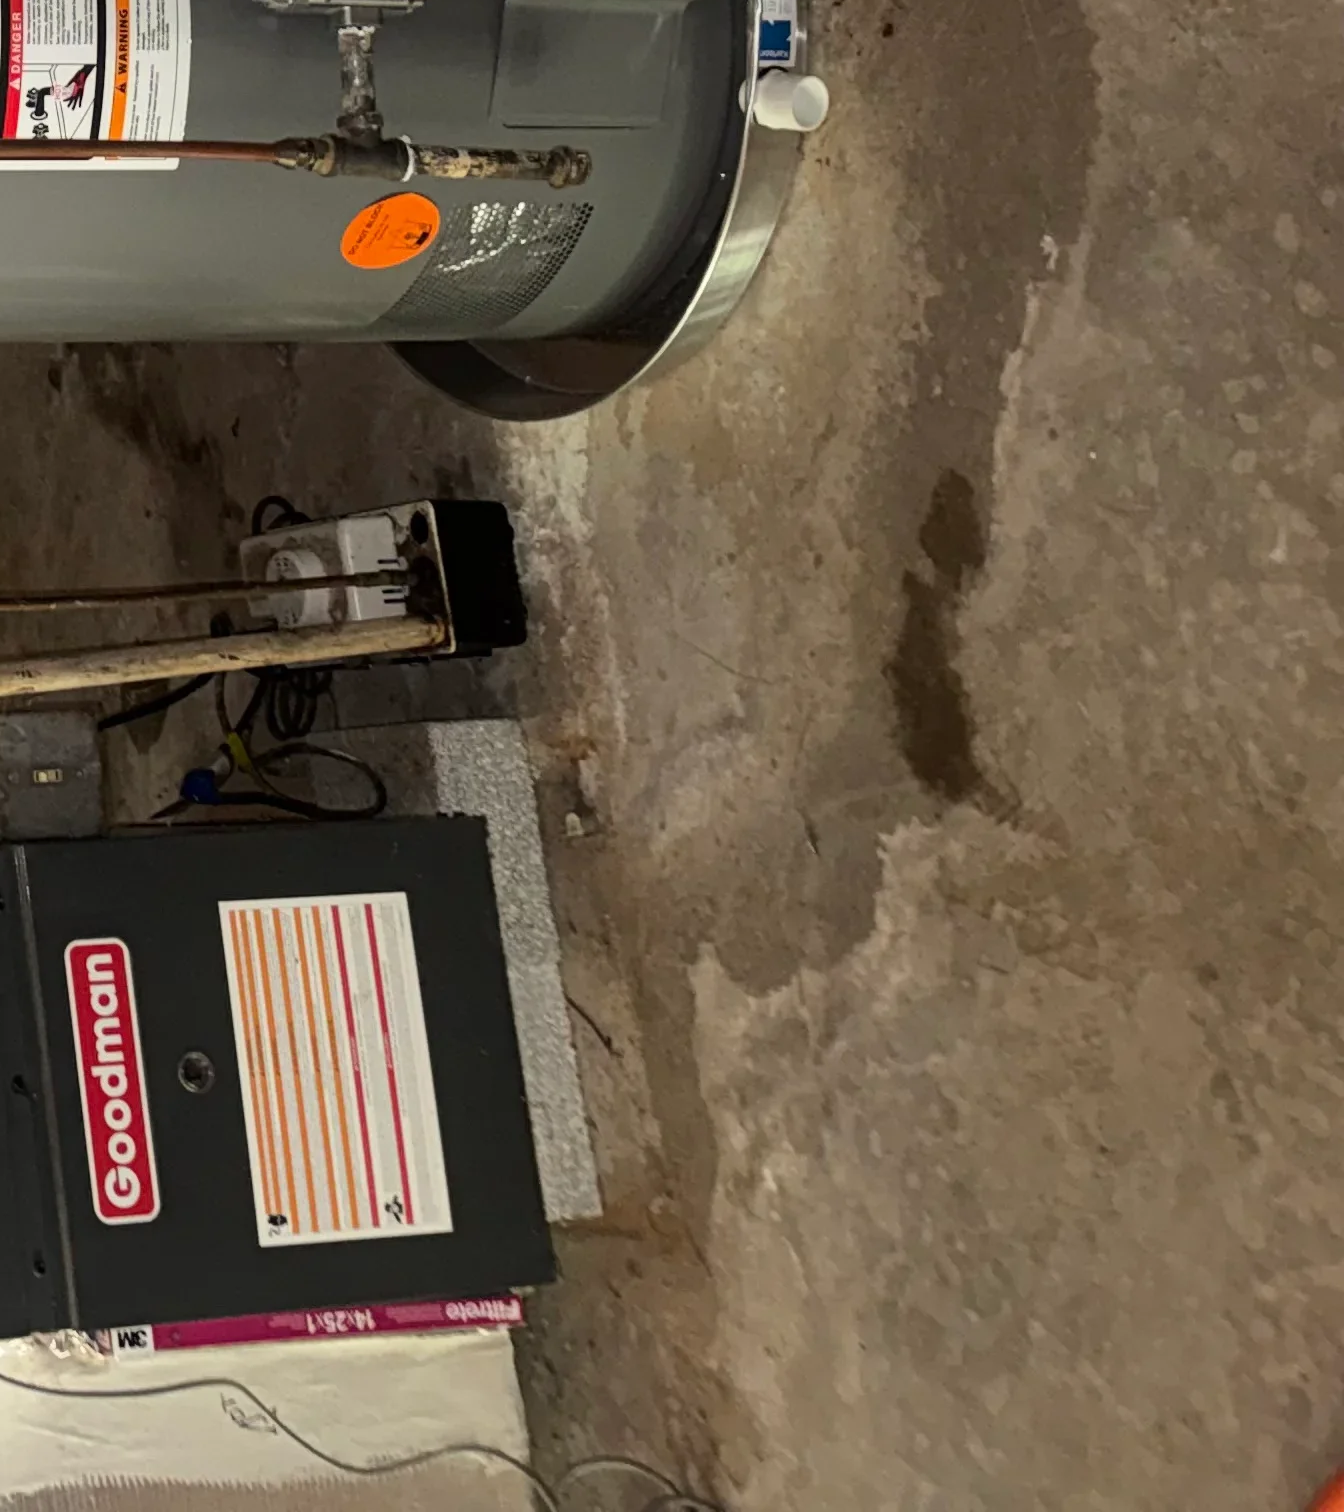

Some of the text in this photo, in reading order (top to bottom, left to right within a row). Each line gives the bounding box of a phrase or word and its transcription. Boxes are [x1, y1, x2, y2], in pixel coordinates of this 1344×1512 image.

[11, 12, 21, 74] DANGER
[118, 8, 128, 75] WARNING
[54, 84, 62, 100] HOT
[85, 952, 141, 1209] Goodman
[117, 1329, 148, 1349] 3M
